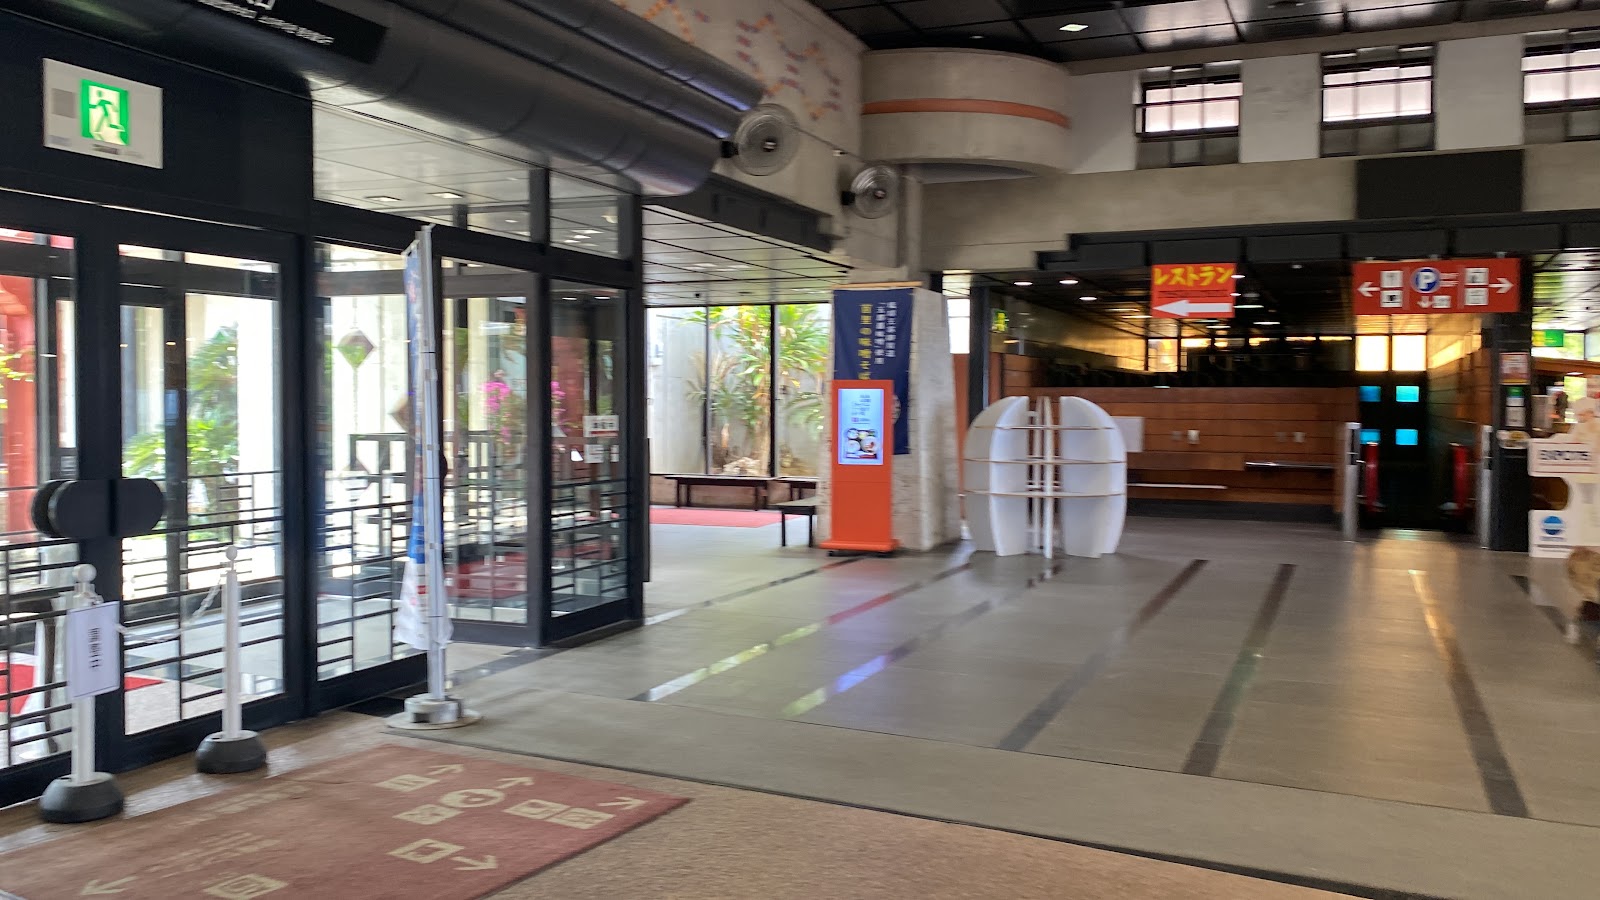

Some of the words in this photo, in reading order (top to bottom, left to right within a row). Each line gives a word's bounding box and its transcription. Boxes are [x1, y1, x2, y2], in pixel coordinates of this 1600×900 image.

[1153, 266, 1234, 287] レストラン
[1419, 271, 1435, 290] P
